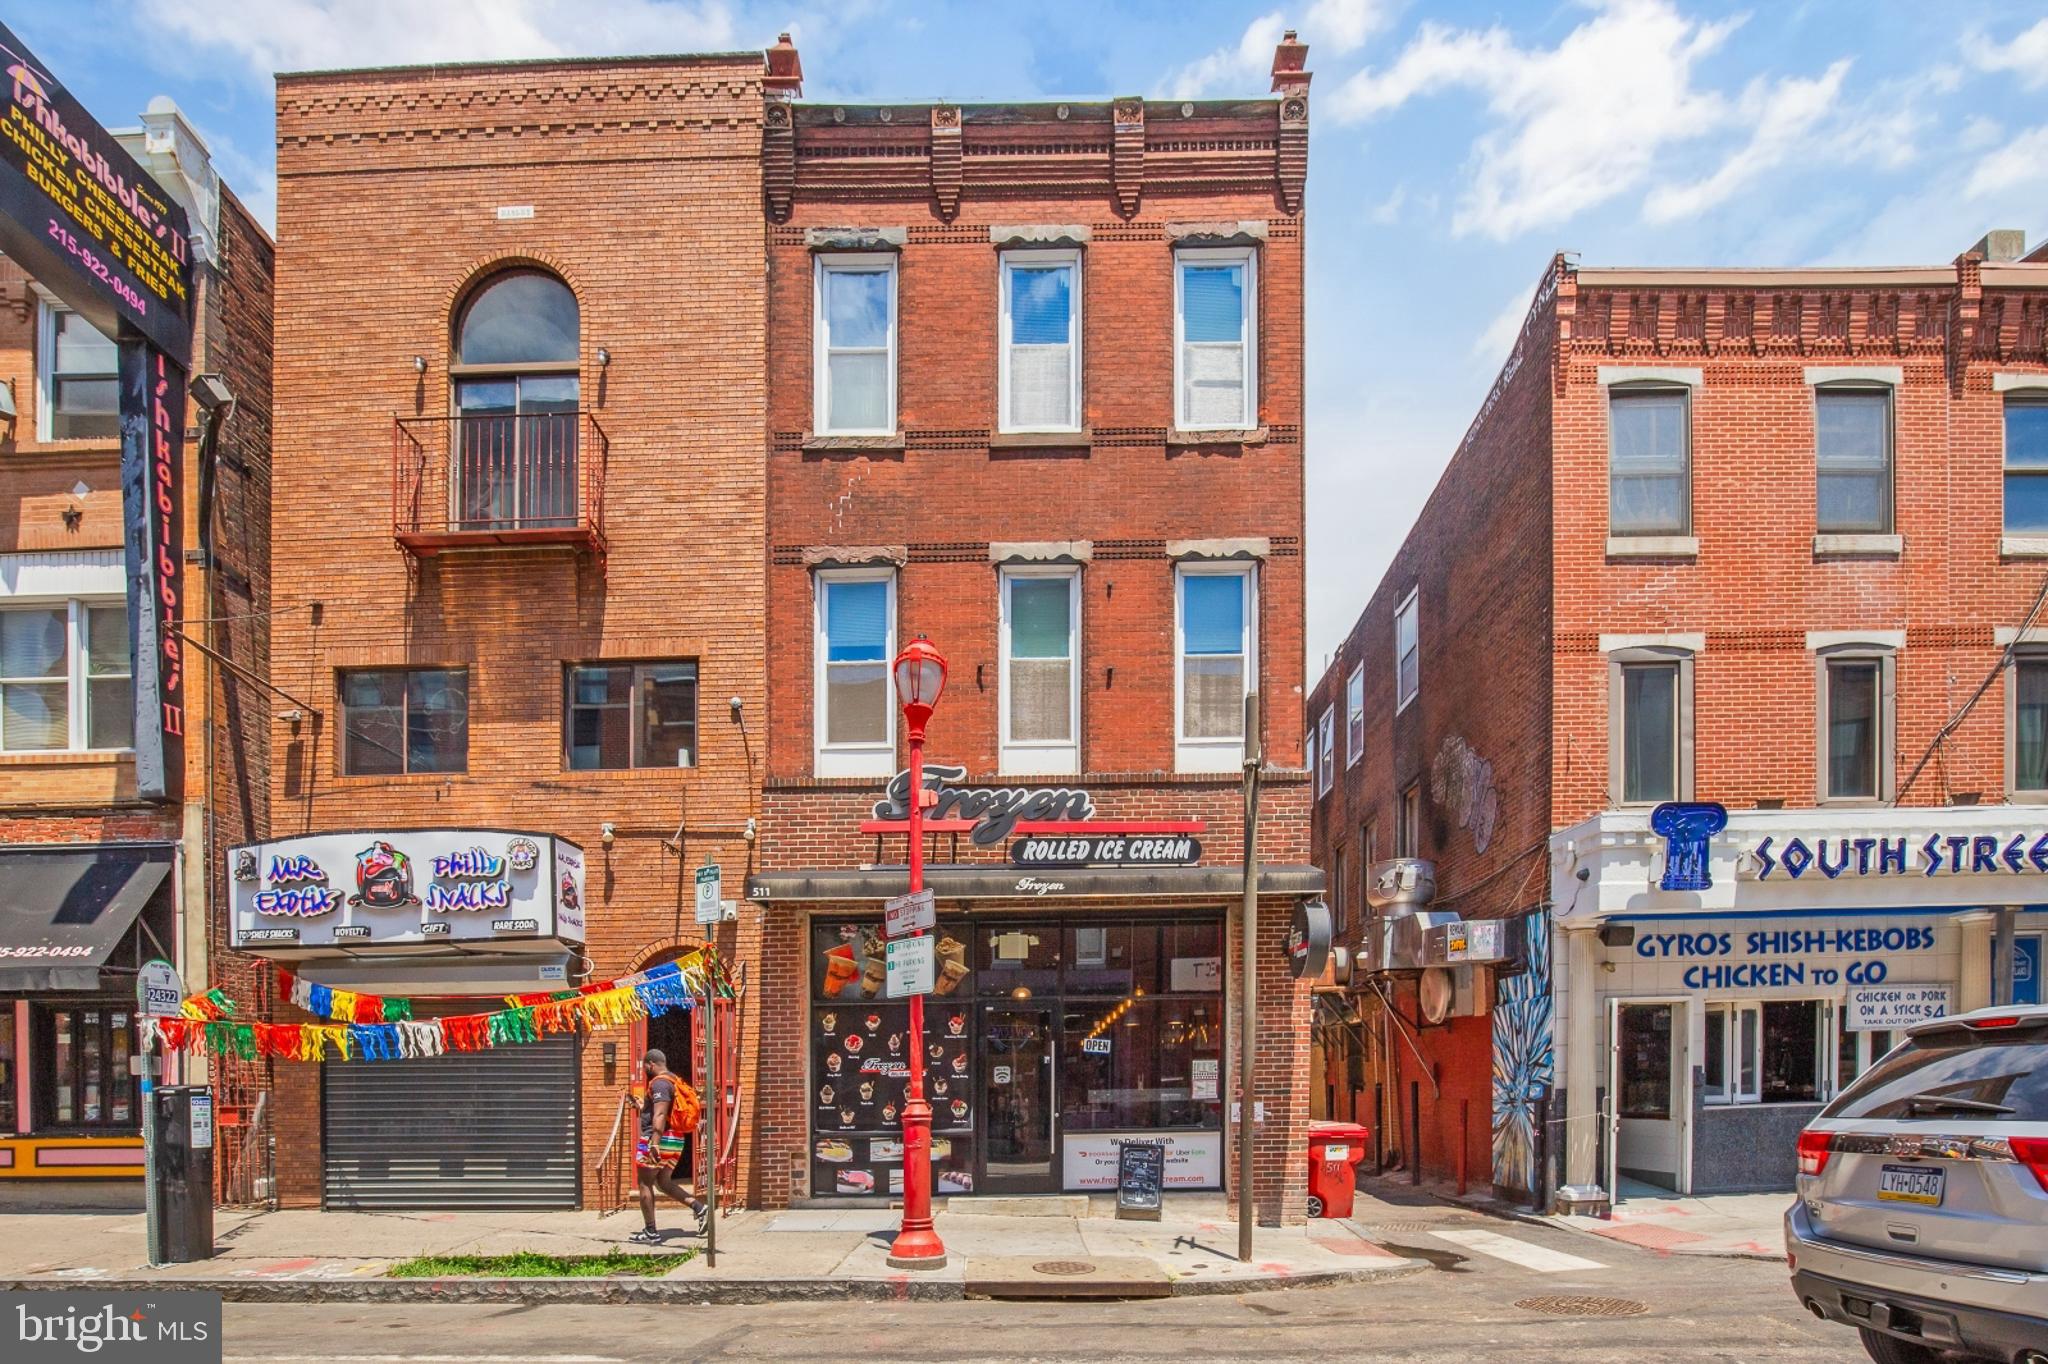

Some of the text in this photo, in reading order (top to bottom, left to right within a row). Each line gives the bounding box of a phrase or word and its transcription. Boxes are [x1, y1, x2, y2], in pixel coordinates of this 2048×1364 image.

[11, 104, 180, 276] PHILLY CHEESESTEAK
[0, 117, 186, 300] CHICKEN CHEESESTEAK
[26, 161, 103, 240] BURGERS
[110, 240, 122, 258] &
[127, 254, 168, 299] FRIES
[48, 218, 147, 316] 215-922-0494
[872, 765, 1096, 845] Frozen
[1022, 839, 1192, 861] ROLLED ICE CREAM
[1753, 836, 1906, 881] SOUTH
[425, 880, 511, 913] SNACKS
[752, 887, 770, 897] 511
[1015, 877, 1065, 895] Frozen
[335, 927, 365, 937] NOVELTY
[421, 923, 446, 934] GIFT
[514, 920, 535, 930] SODA
[1636, 926, 1935, 957] GYROS SHISH-KEBOBS
[1683, 961, 1887, 989] CHICKEN TO GO
[1856, 991, 1901, 1002] CHICKEN
[1921, 991, 1946, 1001] PORK
[1860, 1004, 1945, 1018] ON A STICK $4
[1086, 1040, 1109, 1052] OPEN
[1155, 1136, 1175, 1145] With
